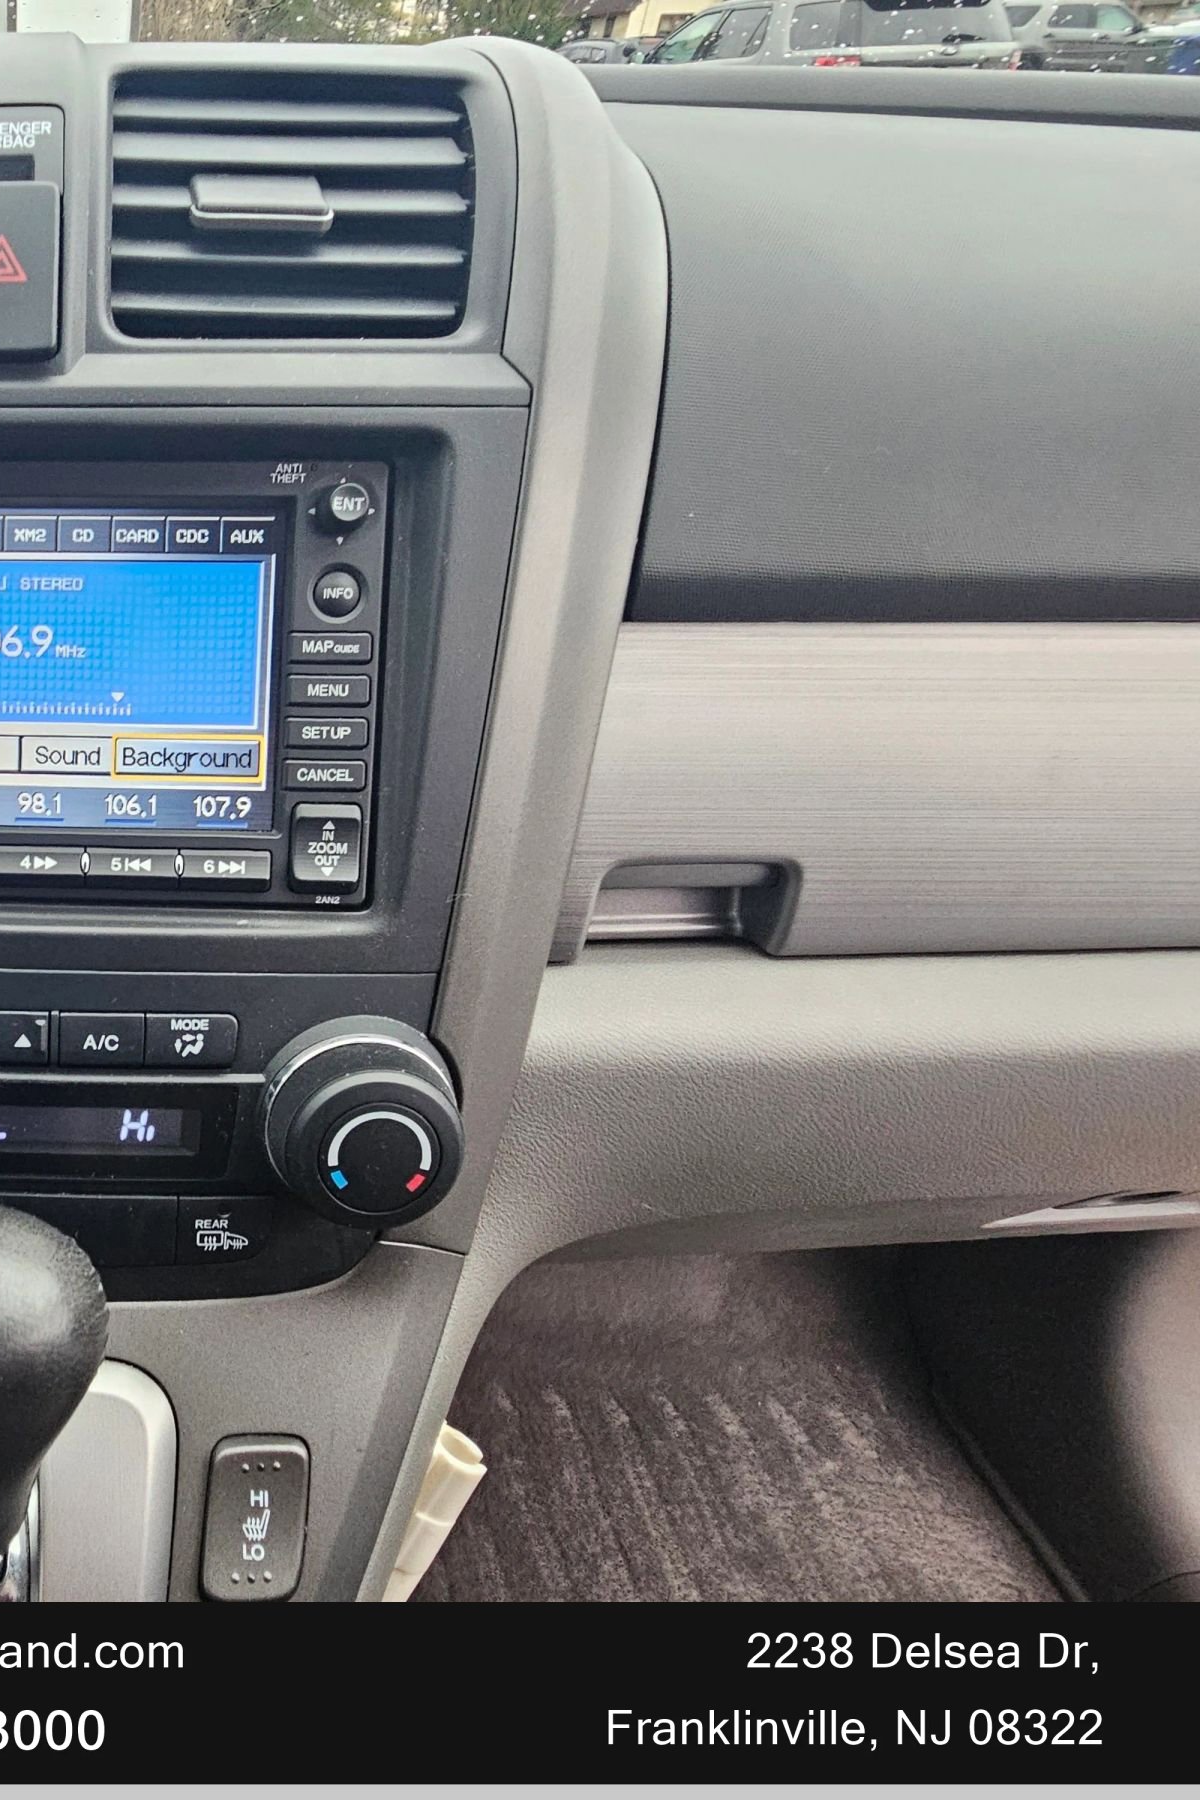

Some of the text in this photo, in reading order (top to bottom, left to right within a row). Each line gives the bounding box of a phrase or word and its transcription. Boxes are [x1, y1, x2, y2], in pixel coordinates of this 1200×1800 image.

[275, 463, 303, 474] ANTI
[270, 473, 306, 484] THEFT
[332, 497, 365, 511] ENT
[14, 528, 47, 543] XM2
[72, 529, 94, 543] CD
[116, 529, 159, 543] CARD
[176, 529, 209, 544] CDC
[230, 529, 264, 545] AUX
[19, 577, 83, 592] STEREO
[323, 587, 353, 600] INFO
[55, 645, 87, 659] MHz
[307, 684, 349, 697] MENU
[35, 746, 101, 766] Sound
[121, 747, 252, 773] Background
[296, 768, 354, 782] CANCEL
[322, 830, 335, 841] IN
[307, 842, 348, 855] ZOOM
[20, 856, 32, 870] 4
[111, 858, 122, 871] 5
[203, 860, 215, 873] 6
[314, 855, 339, 867] OUT
[170, 1019, 210, 1031] MODE
[83, 1033, 119, 1052] A/C
[195, 1218, 229, 1230] REAR
[250, 1489, 269, 1508] HI
[242, 1543, 265, 1561] LO
